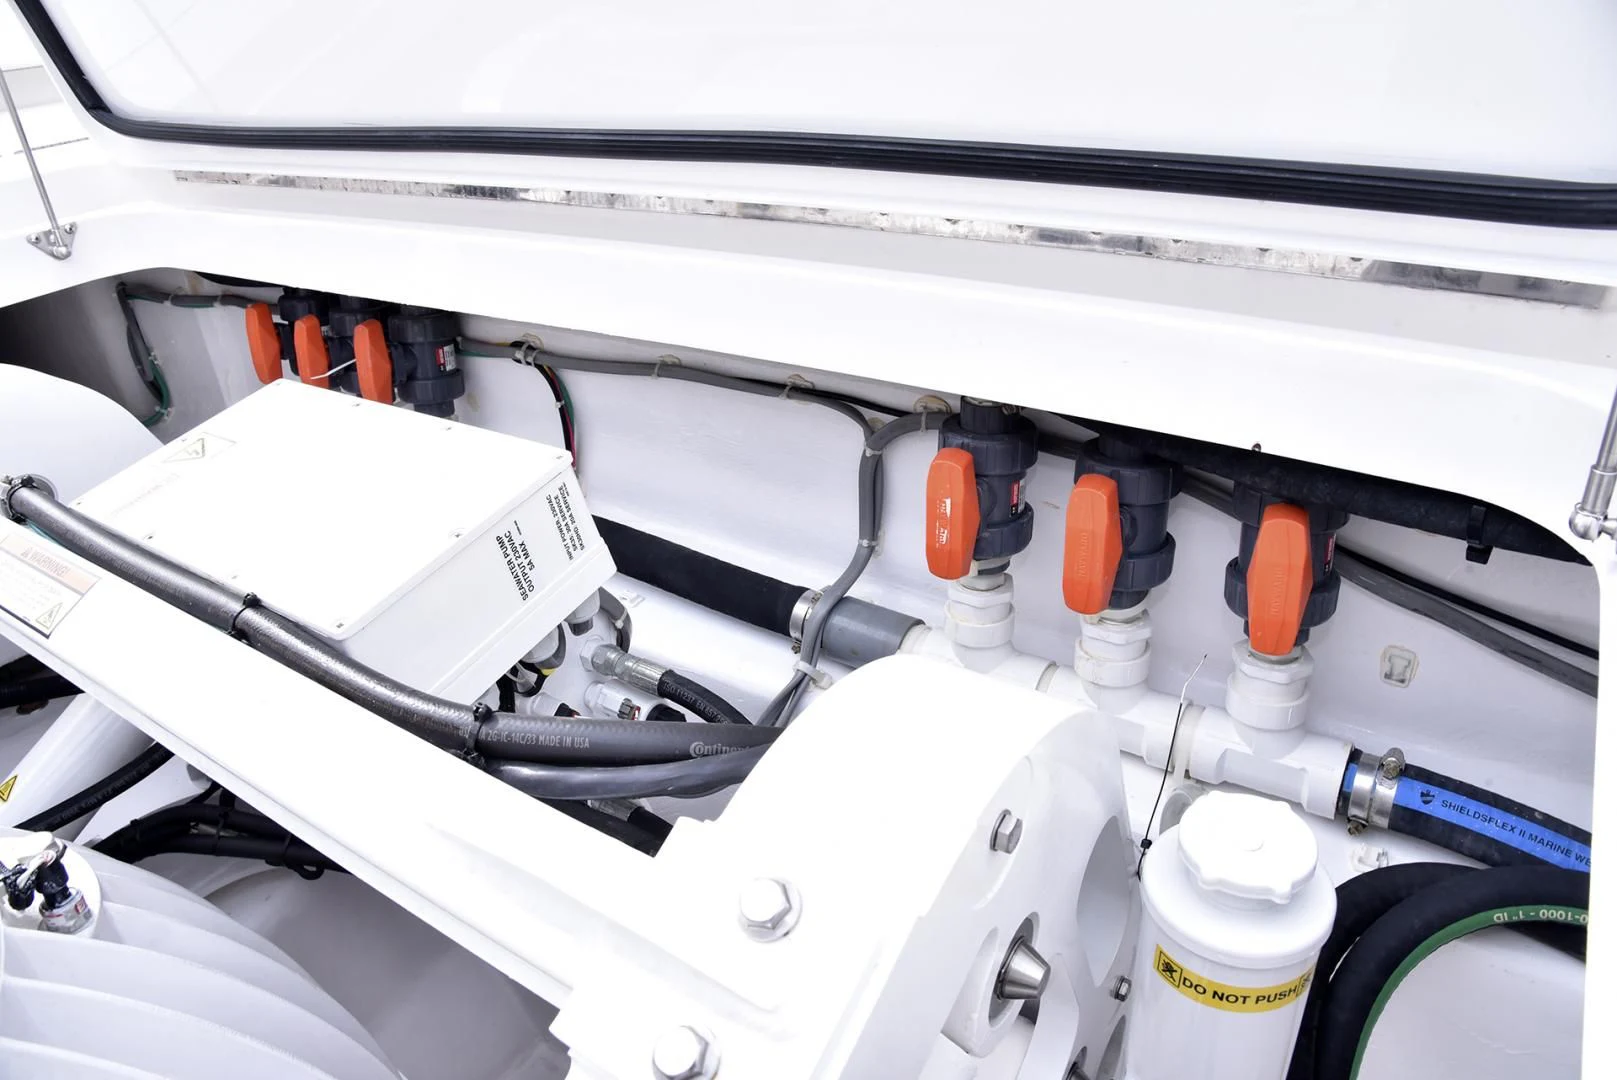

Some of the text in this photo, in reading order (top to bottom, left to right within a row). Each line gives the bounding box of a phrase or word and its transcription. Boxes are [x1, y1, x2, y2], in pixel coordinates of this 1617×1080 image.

[546, 494, 558, 518] 230VAC
[554, 494, 567, 522] SERVICE
[558, 485, 572, 513] SERVICE
[504, 530, 521, 561] 230VAC
[518, 540, 530, 560] MAX
[563, 543, 574, 561] INPUT
[495, 535, 528, 601] SEAWATER PUMP
[517, 561, 535, 593] OUTPUT
[527, 558, 535, 571] 5A
[538, 734, 561, 748] MADE
[562, 735, 572, 748] IN
[574, 736, 590, 749] USA
[1441, 799, 1516, 834] SHIELDSFLEX
[1527, 832, 1573, 858] MARINE
[1493, 912, 1509, 924] ID
[1182, 976, 1297, 1005] DO NOT PUSH
